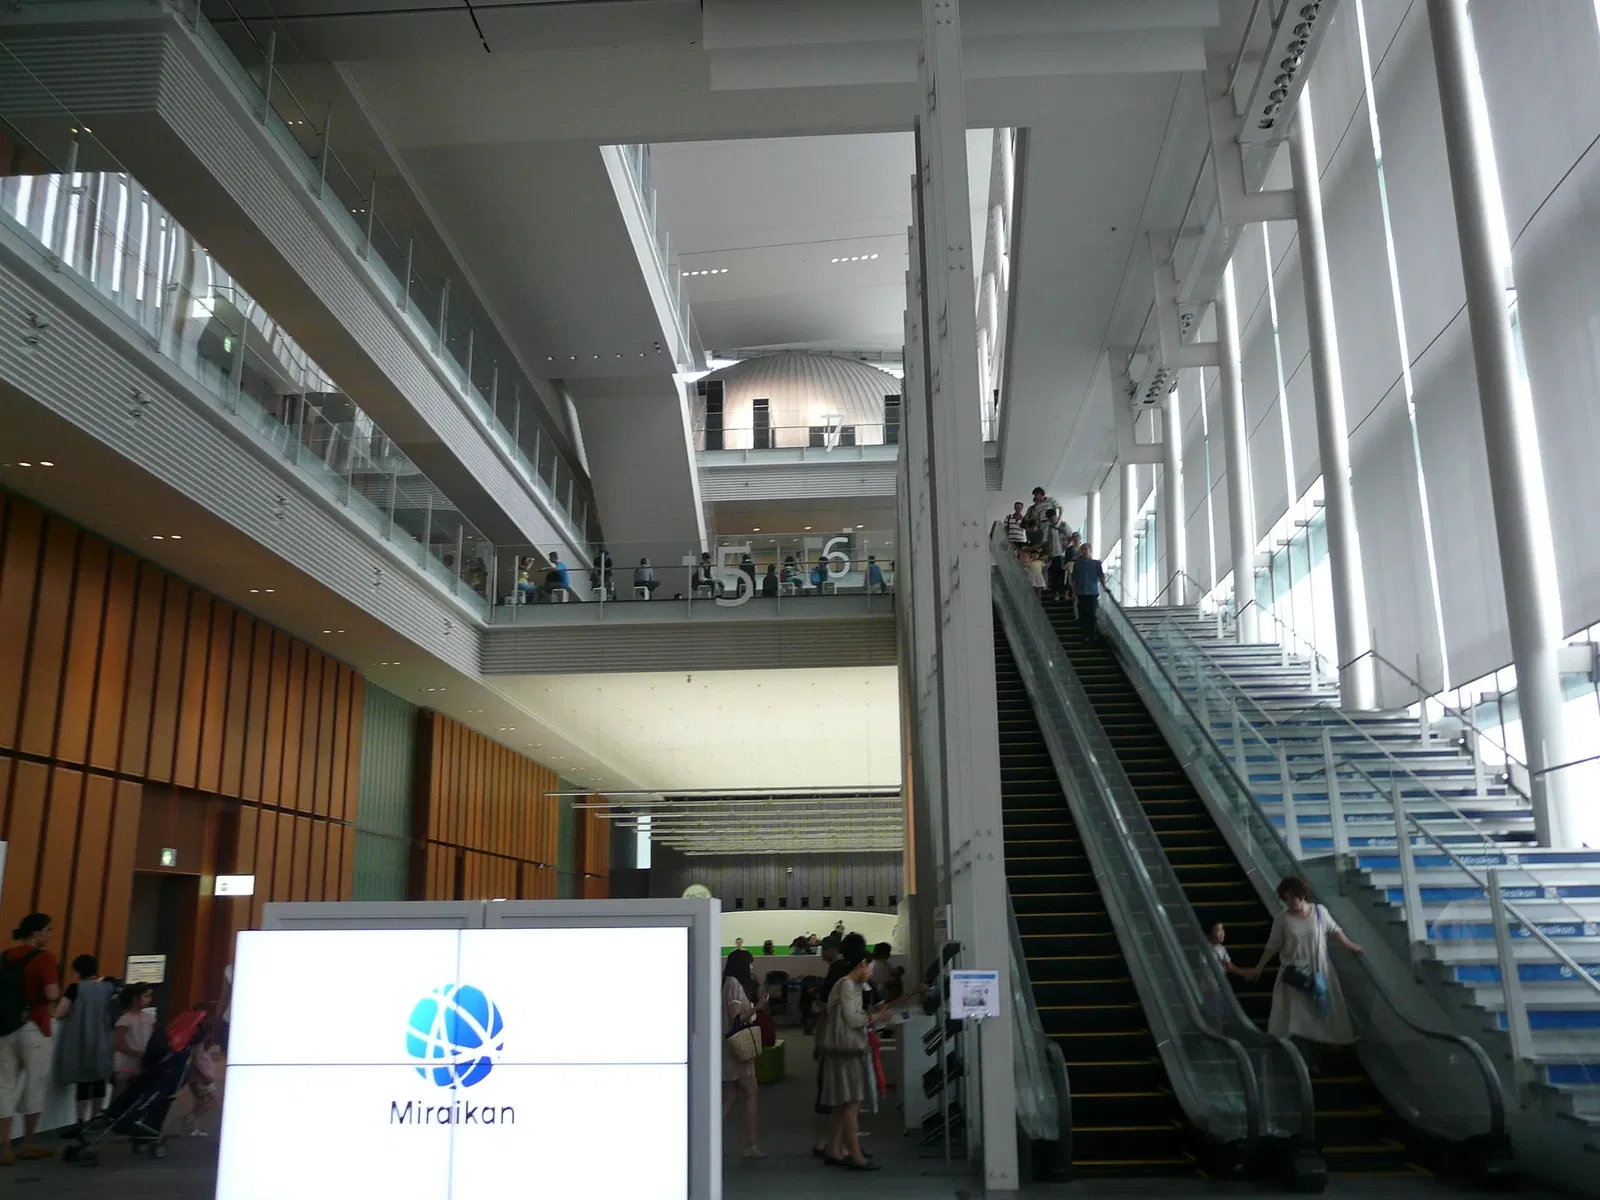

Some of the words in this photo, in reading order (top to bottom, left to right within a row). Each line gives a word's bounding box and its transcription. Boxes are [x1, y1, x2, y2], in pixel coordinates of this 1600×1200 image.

[820, 414, 845, 452] 7
[715, 546, 754, 607] 5
[823, 537, 850, 578] 6
[390, 1100, 515, 1124] Miraikan
